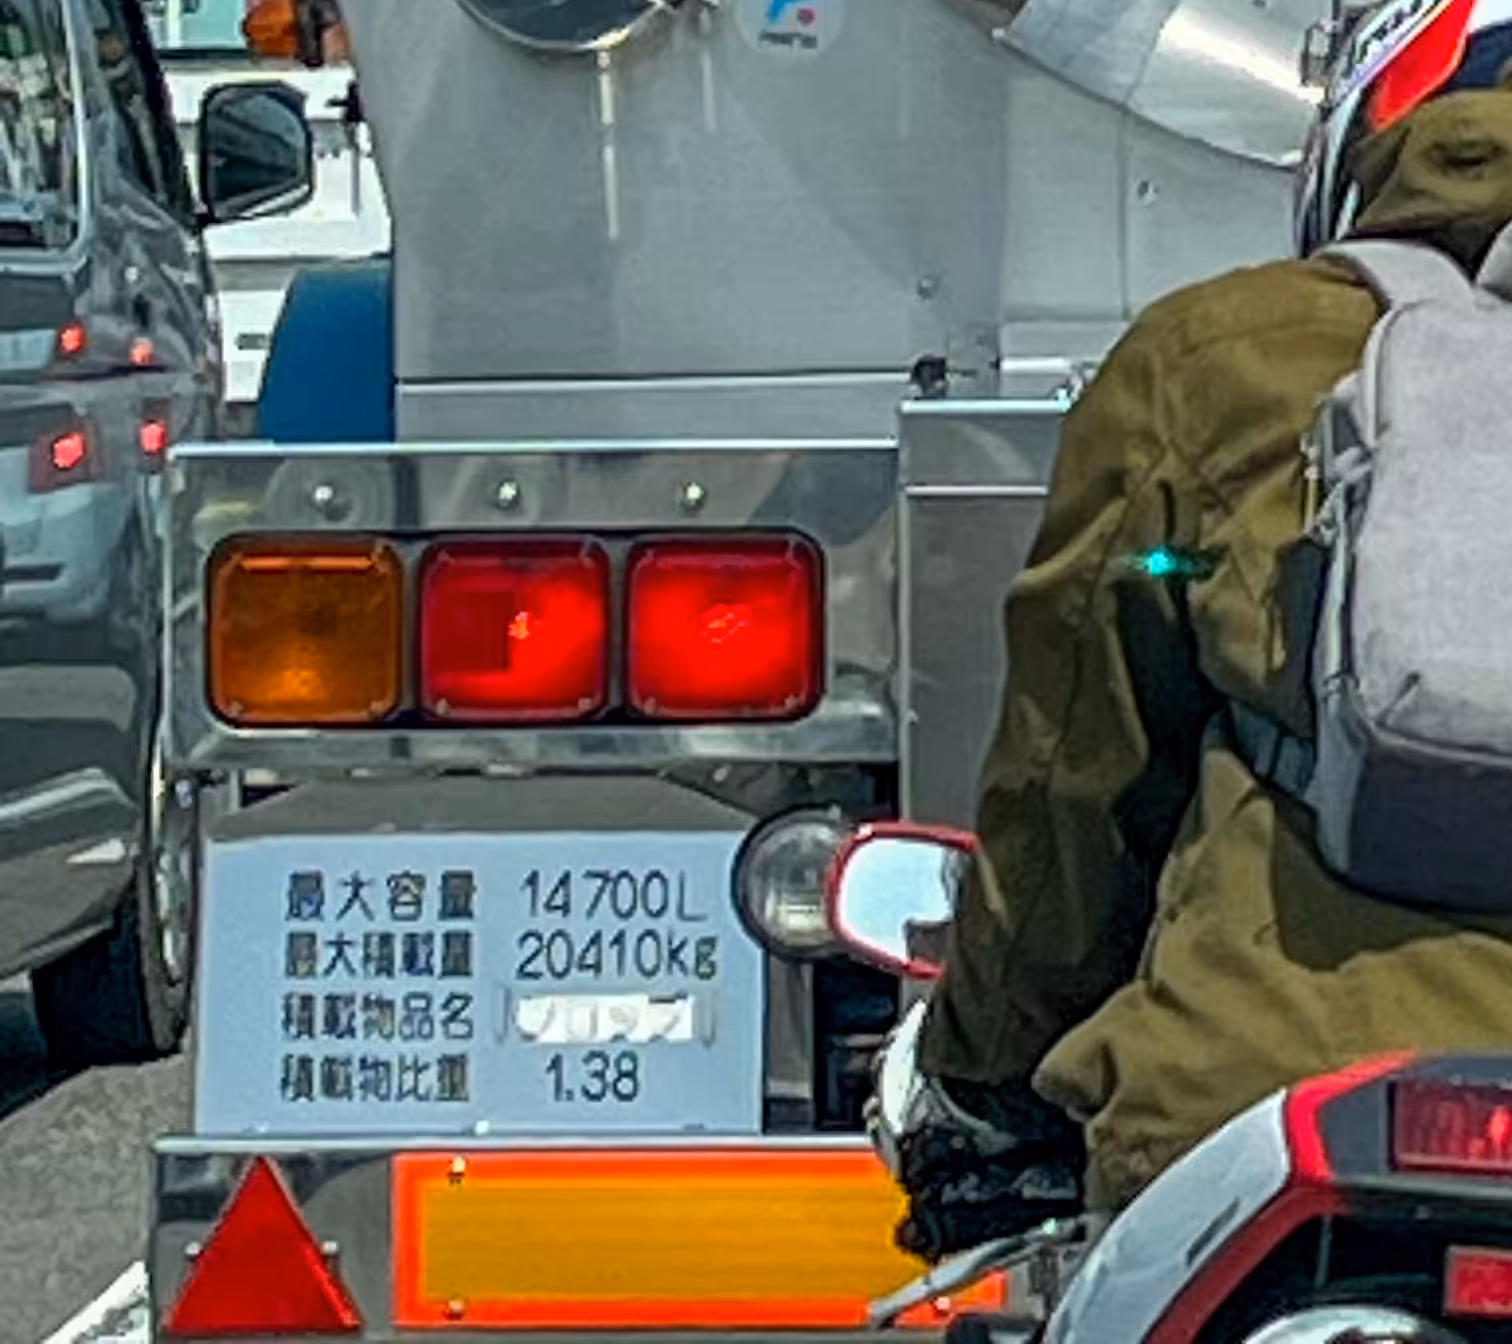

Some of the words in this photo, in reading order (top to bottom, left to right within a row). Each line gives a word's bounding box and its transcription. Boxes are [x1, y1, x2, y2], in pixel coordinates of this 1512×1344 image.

[284, 869, 477, 922] 最大容量
[520, 869, 708, 922] 14700L
[283, 930, 474, 980] 最大積載量
[514, 929, 720, 980] 20410kg
[281, 990, 474, 1041] 積載物品名
[280, 1053, 470, 1103] 積載物比重
[544, 1051, 639, 1102] 1.38
